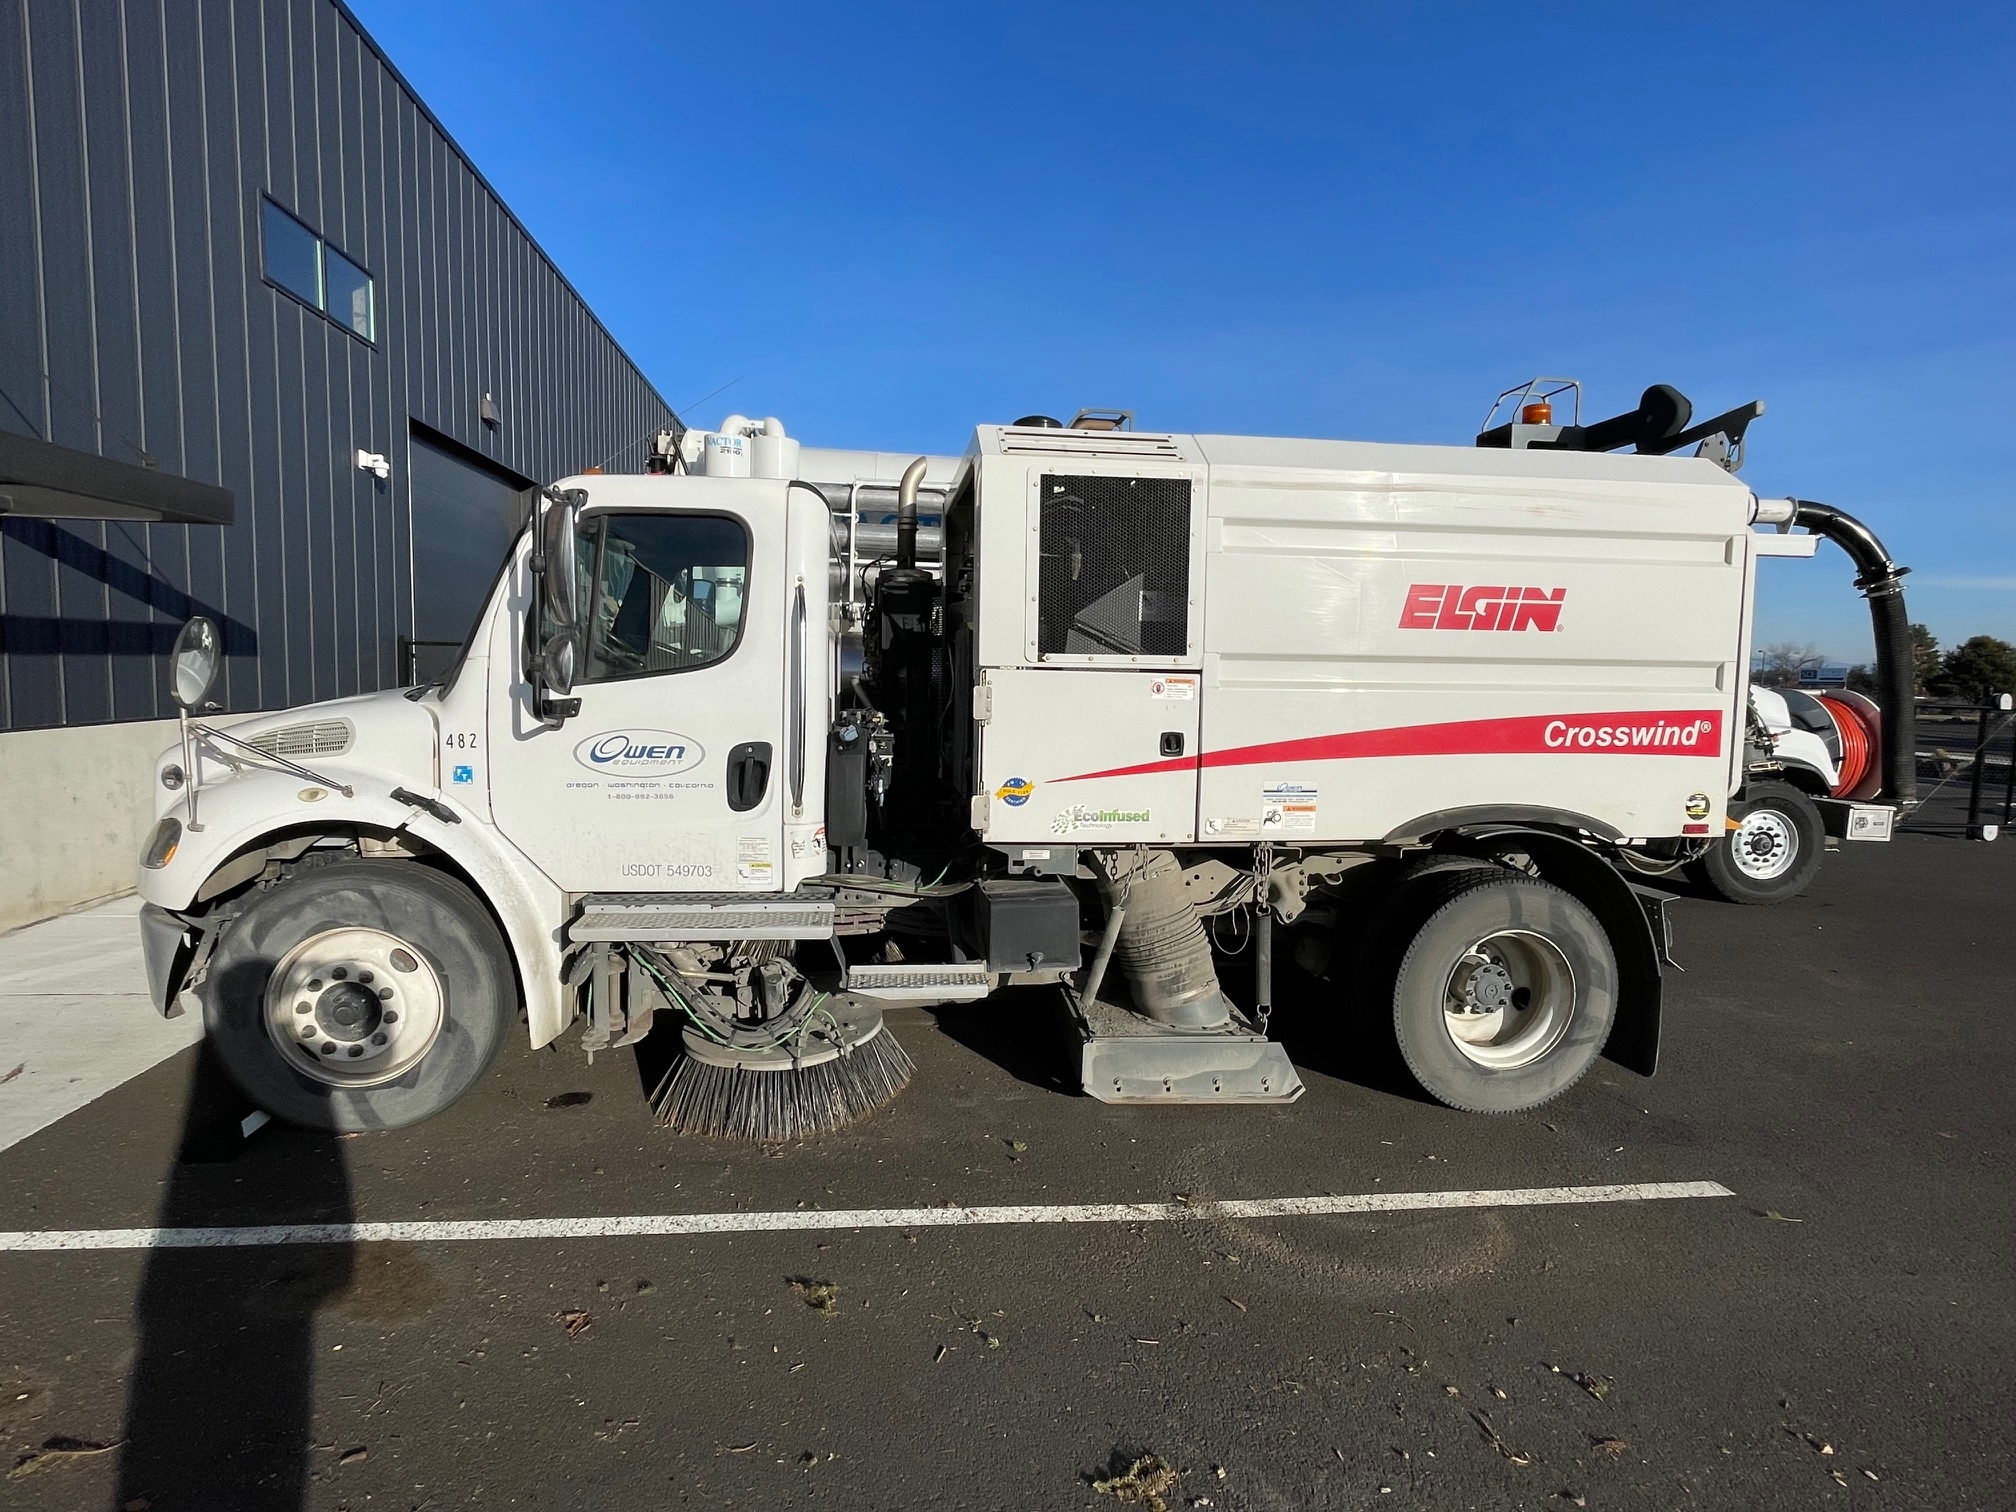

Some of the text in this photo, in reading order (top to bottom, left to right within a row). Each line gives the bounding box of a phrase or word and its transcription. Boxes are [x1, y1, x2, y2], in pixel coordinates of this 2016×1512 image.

[706, 436, 742, 448] VACTOR
[1398, 584, 1567, 632] ELGIN
[446, 733, 477, 749] 482
[607, 781, 661, 789] washington
[668, 781, 714, 789] california
[1073, 808, 1150, 822] EcoInfused
[621, 864, 713, 877] USDOT 549703
